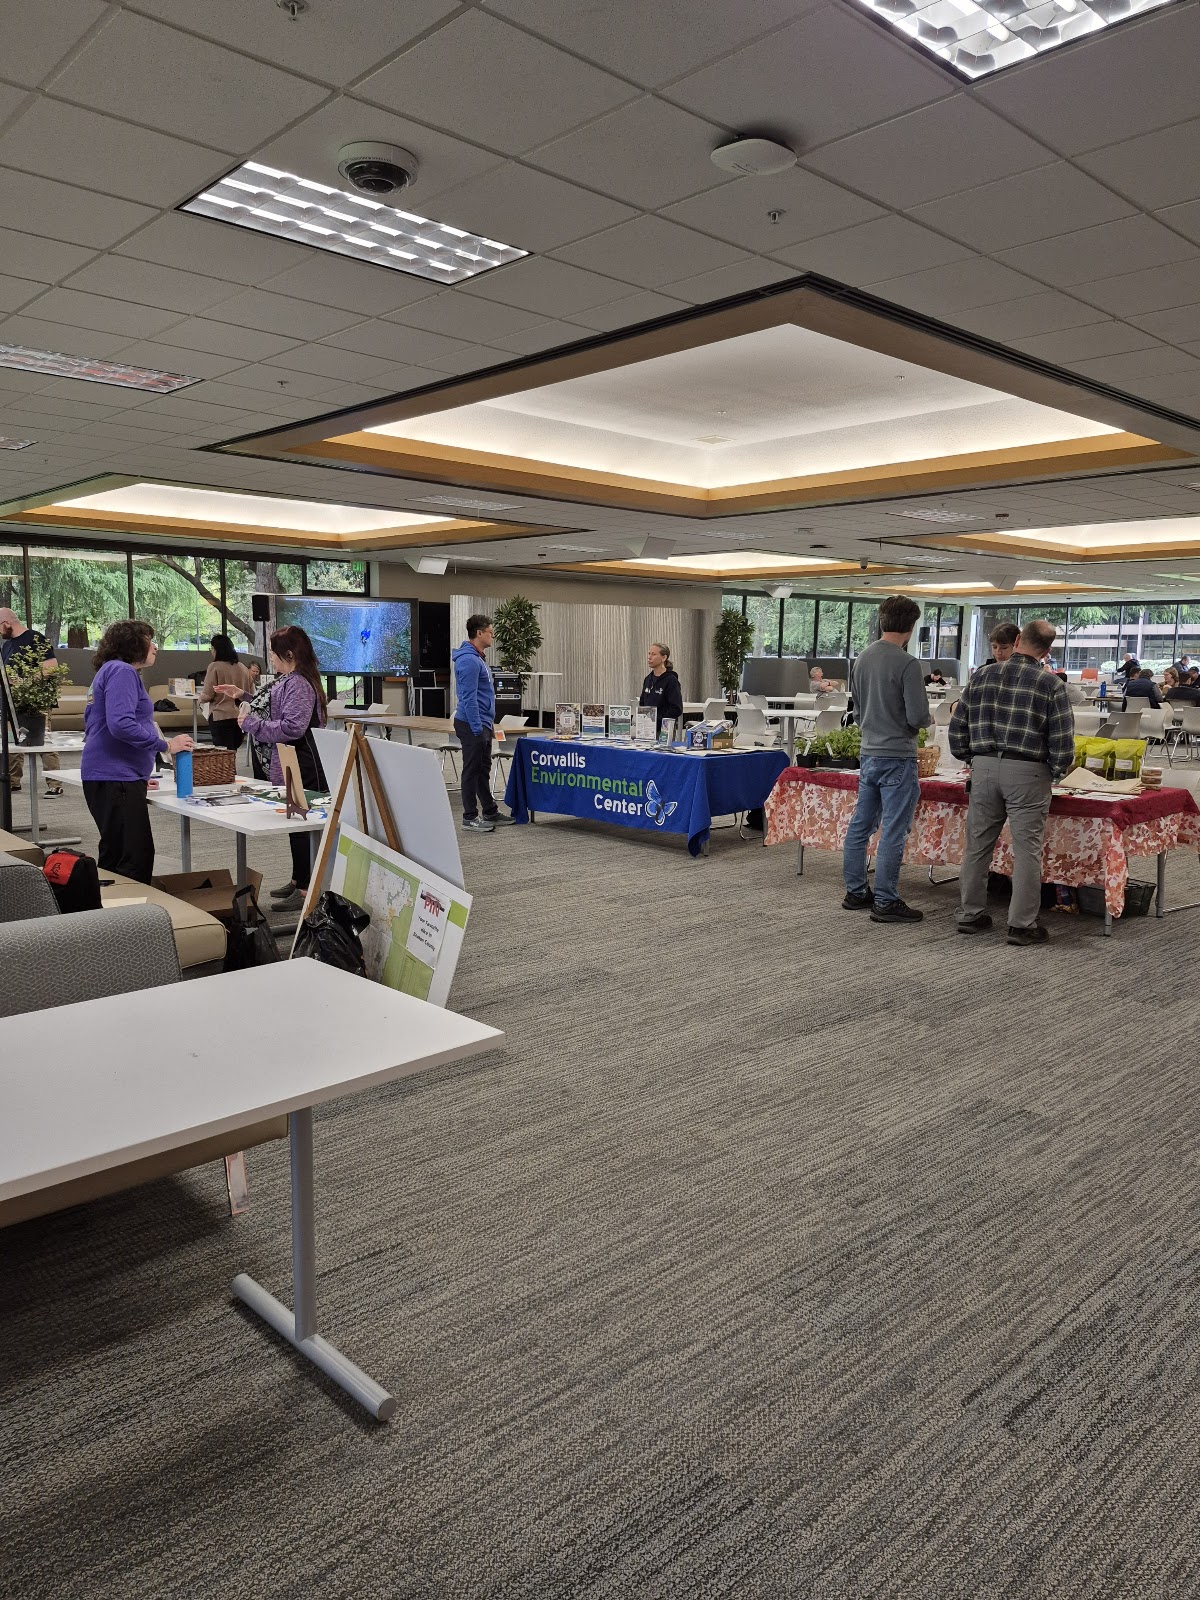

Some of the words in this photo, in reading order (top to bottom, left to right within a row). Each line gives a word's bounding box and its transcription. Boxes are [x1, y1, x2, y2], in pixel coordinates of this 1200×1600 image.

[530, 750, 586, 768] Corvallis
[531, 766, 643, 797] Environmental
[594, 793, 643, 816] Center
